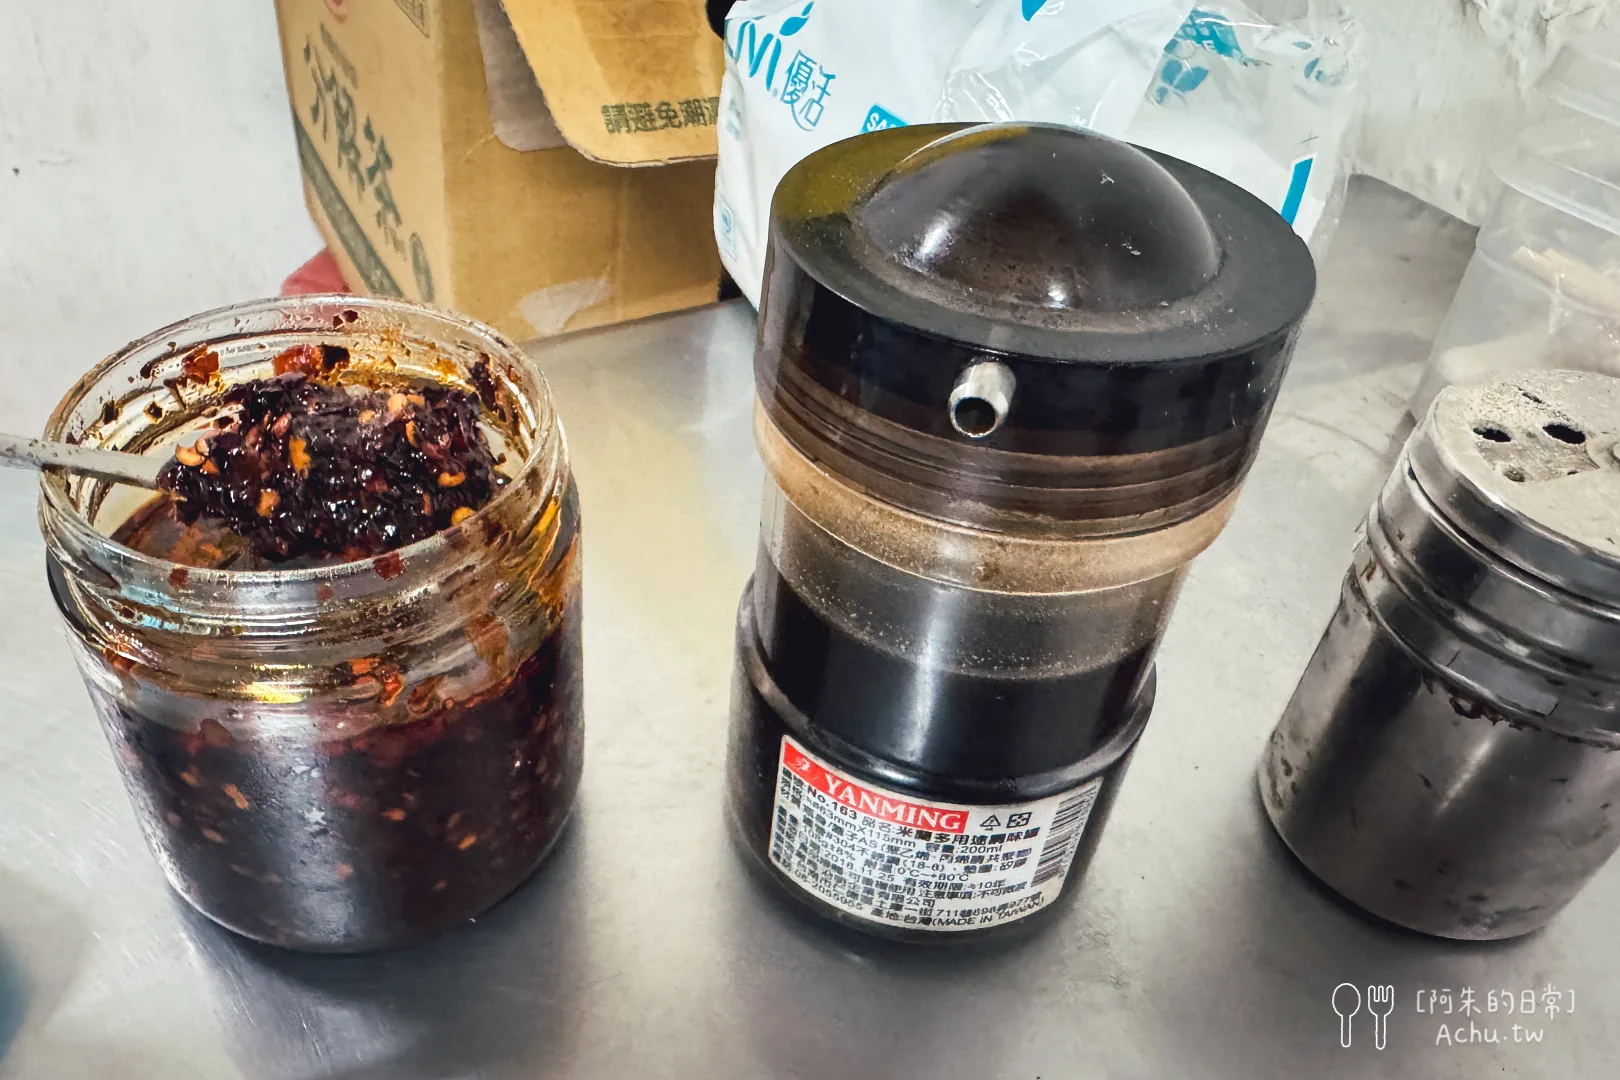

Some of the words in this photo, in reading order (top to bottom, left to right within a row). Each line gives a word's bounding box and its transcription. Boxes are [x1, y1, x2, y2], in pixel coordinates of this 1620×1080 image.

[780, 50, 836, 131] 優活
[822, 772, 964, 832] YANMING
[978, 913, 994, 924] IN
